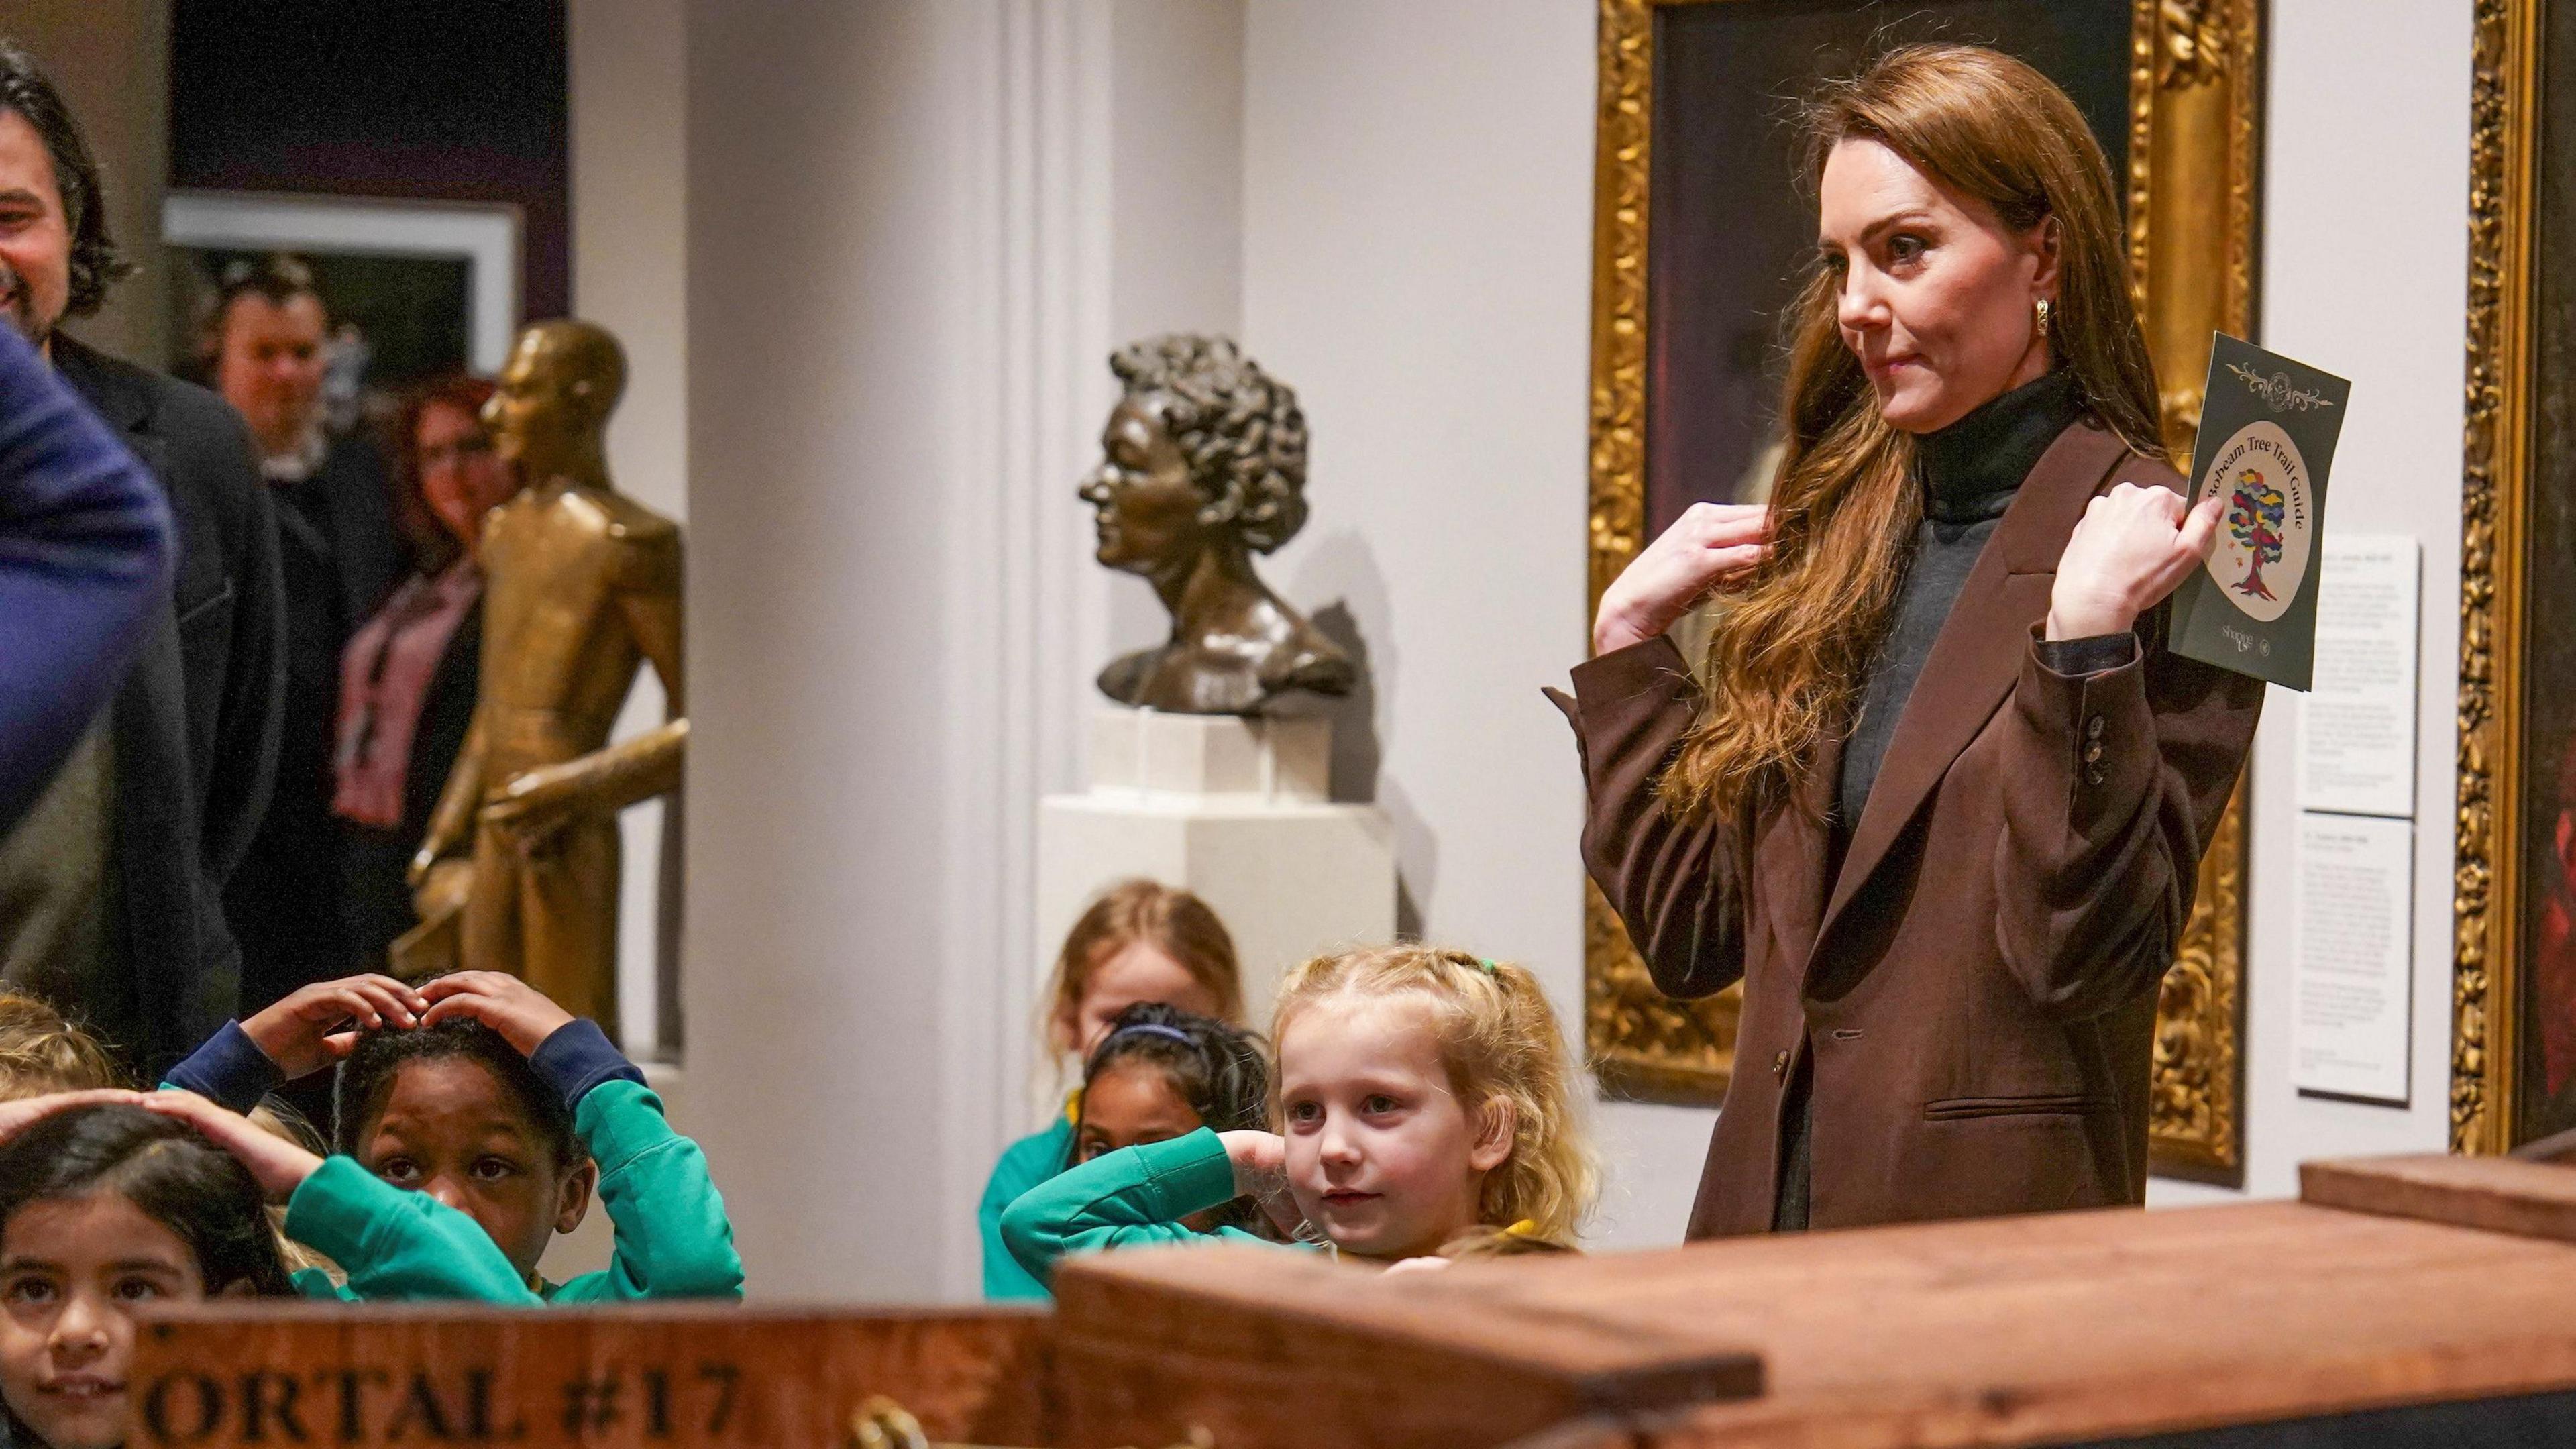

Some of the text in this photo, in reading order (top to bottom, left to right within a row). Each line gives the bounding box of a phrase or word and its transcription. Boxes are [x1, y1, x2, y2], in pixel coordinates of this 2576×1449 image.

[2208, 437, 2304, 530] Bobeam Tree Trail Guide
[562, 1359, 740, 1440] #17
